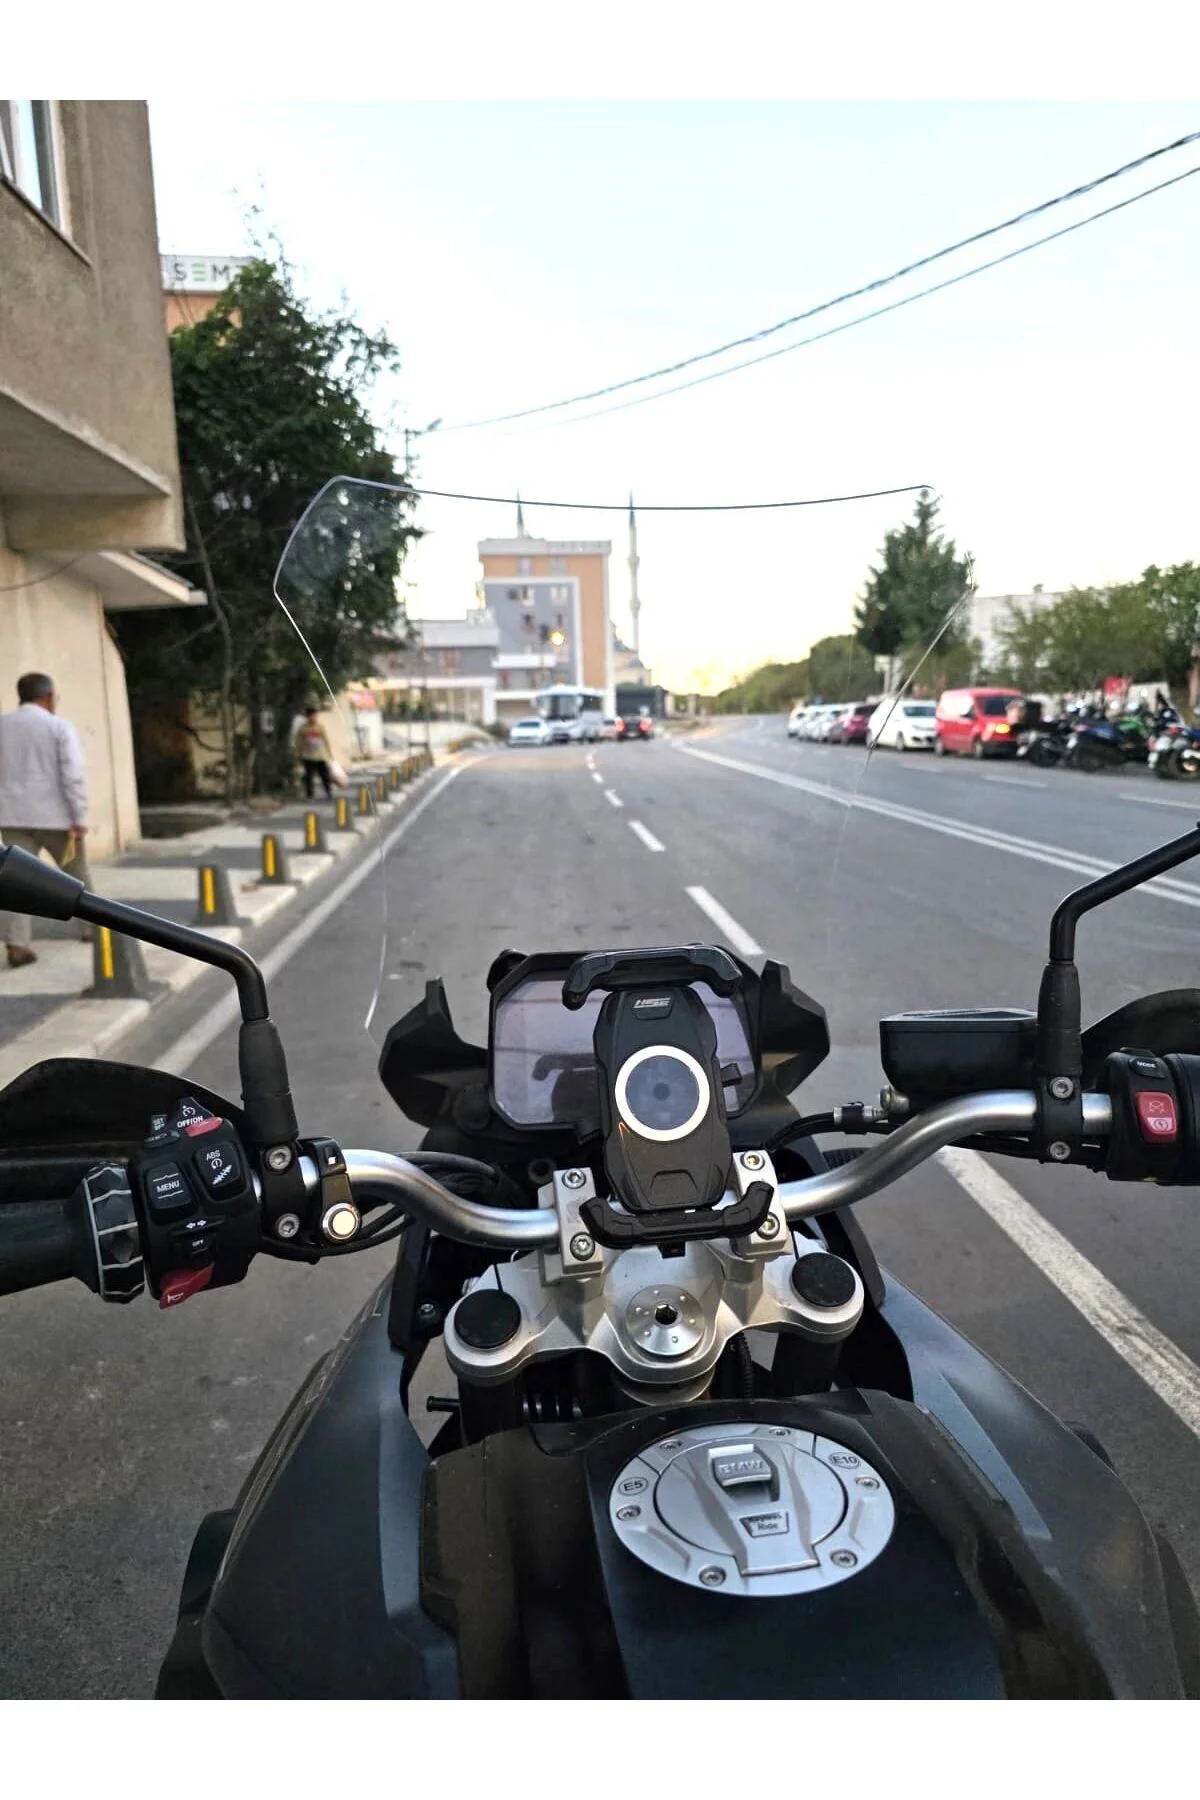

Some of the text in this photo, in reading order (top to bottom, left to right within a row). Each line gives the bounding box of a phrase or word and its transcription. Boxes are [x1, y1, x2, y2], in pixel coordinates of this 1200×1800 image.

[206, 1150, 221, 1160] ABS
[156, 1180, 180, 1193] MENU
[832, 1455, 858, 1464] E10
[718, 1460, 765, 1474] BMW
[624, 1480, 643, 1491] E5
